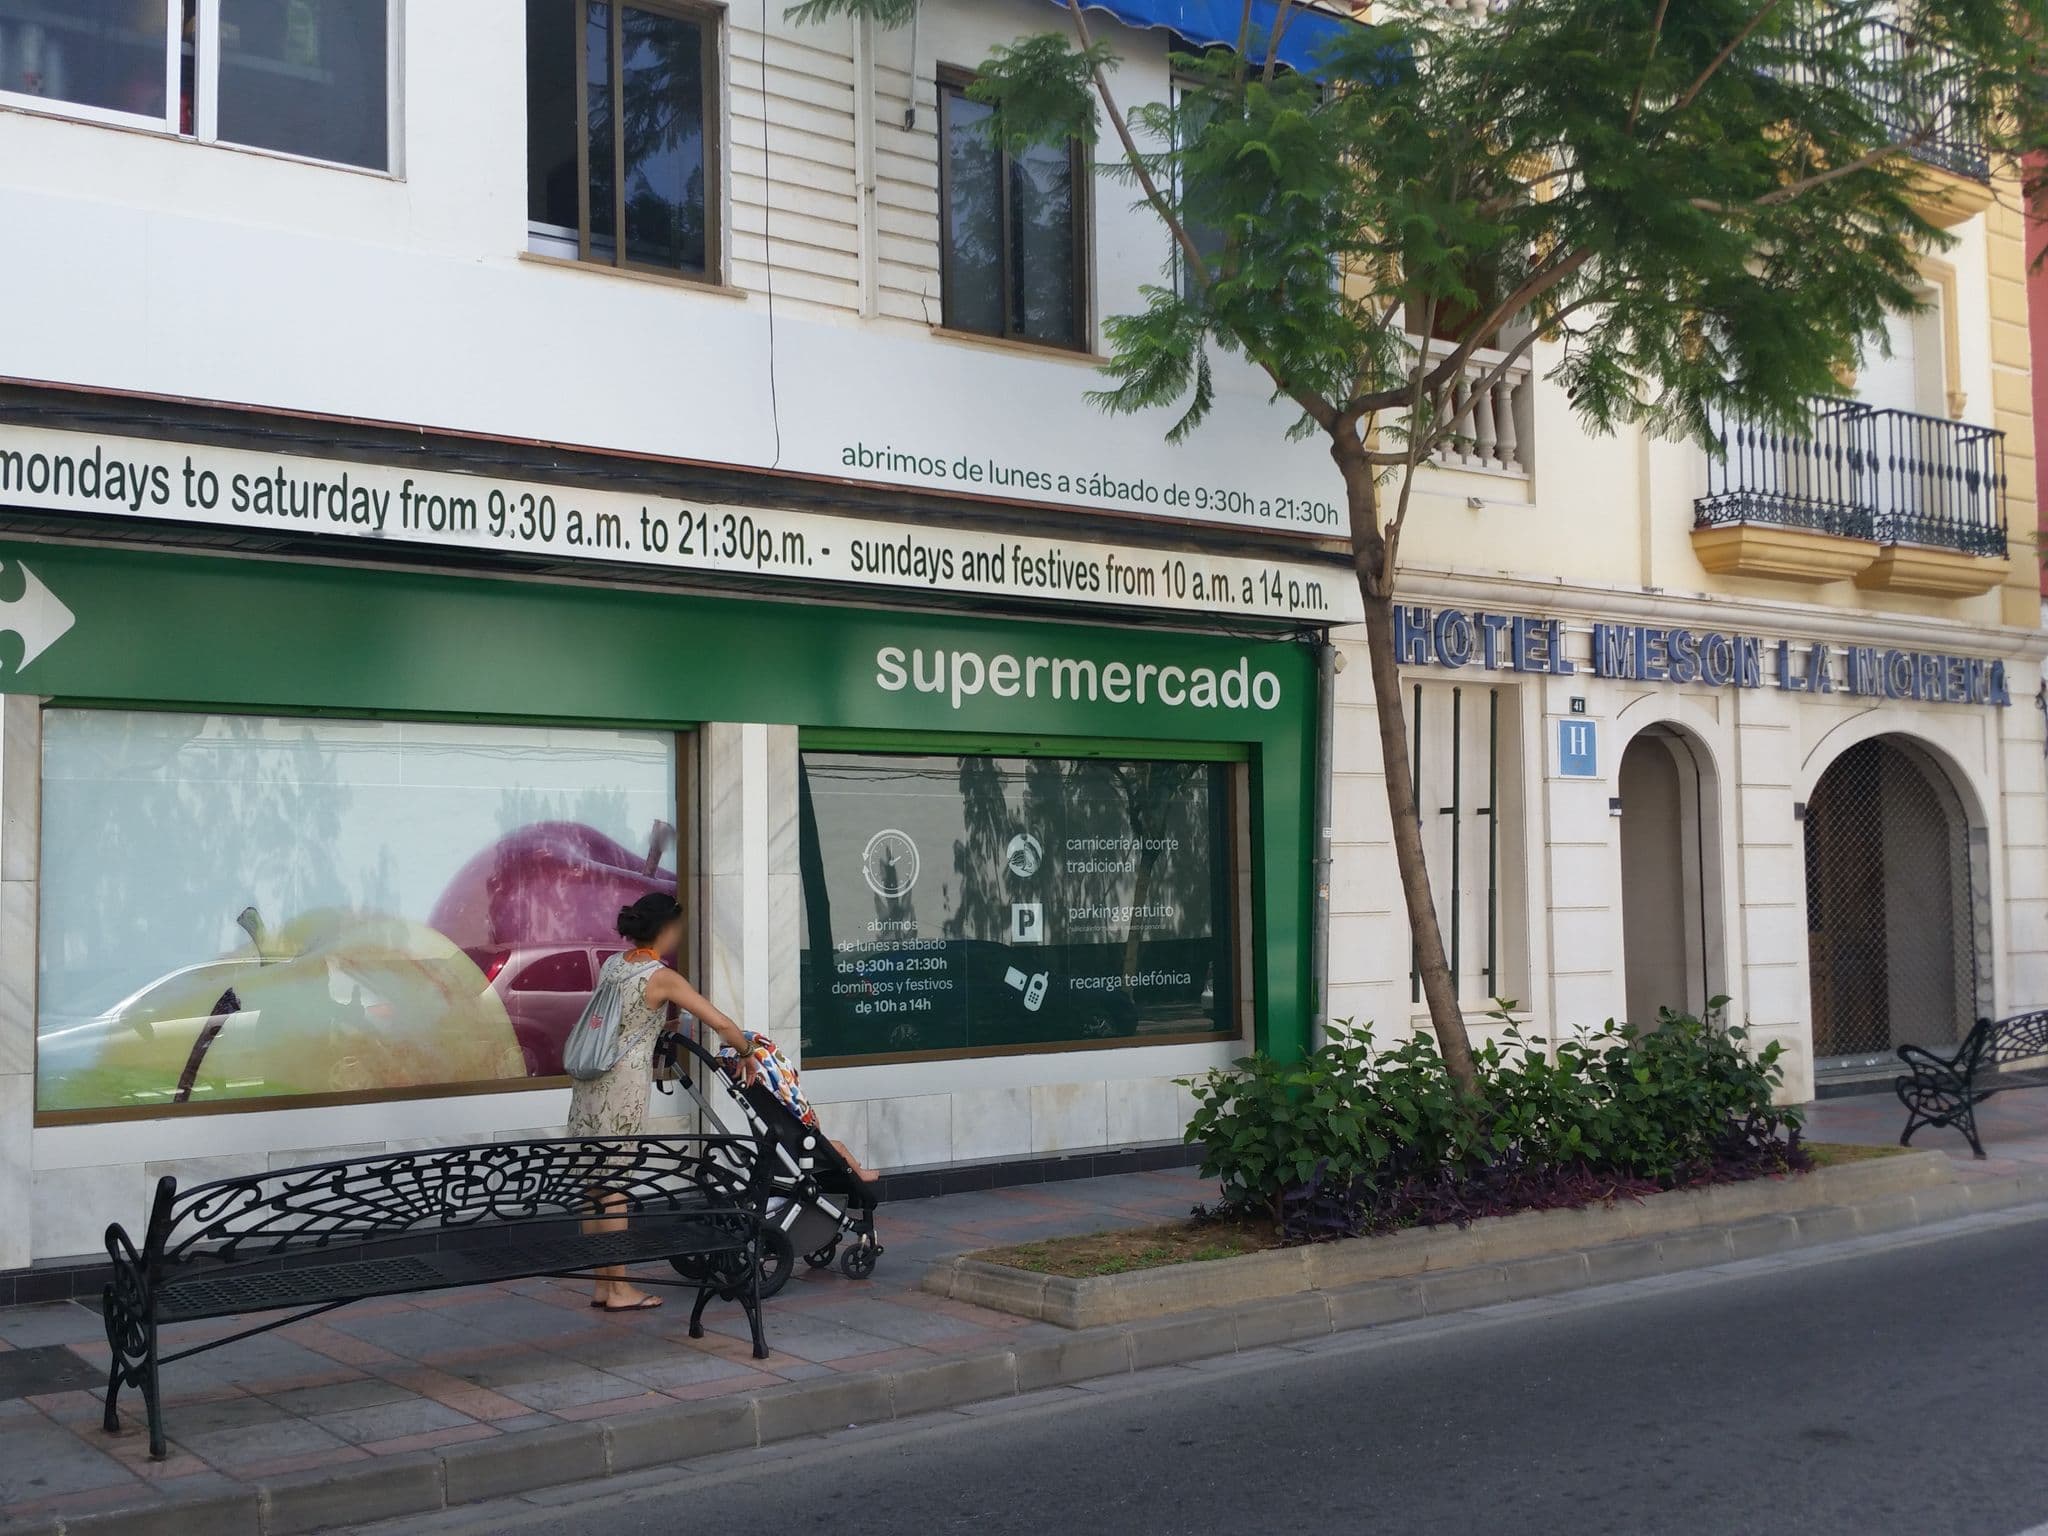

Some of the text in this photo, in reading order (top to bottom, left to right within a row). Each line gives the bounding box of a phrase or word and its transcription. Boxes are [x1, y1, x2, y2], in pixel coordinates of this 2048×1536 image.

[842, 442, 1338, 525] abrimos de lunes a sábado de 9:30h a 21:30h
[0, 445, 170, 511] mondays
[183, 456, 219, 509] to
[232, 466, 390, 531] saturday
[400, 479, 477, 531] from
[488, 489, 556, 542] 9:30
[566, 510, 630, 549] a.m.
[641, 506, 669, 552] to
[851, 534, 953, 584] sundays
[962, 543, 1005, 585] and
[1012, 545, 1100, 592] festives
[1106, 553, 1155, 597] from
[1161, 559, 1186, 599] 10
[1193, 572, 1236, 603] a.m.
[1242, 576, 1253, 605] a
[1259, 569, 1283, 607] 14
[1289, 576, 1328, 612] p.m.
[1393, 605, 2012, 706] HOTEL MESON LA MORENA
[876, 646, 1281, 710] supermercado
[1570, 726, 1588, 756] H
[1131, 836, 1143, 850] al
[1145, 838, 1178, 850] corte
[1067, 858, 1135, 873] tradicional
[1069, 903, 1174, 922] parking gratuito
[867, 918, 918, 931] abrimos
[1019, 909, 1035, 936] P
[838, 938, 946, 952] de lunes a sábado
[838, 957, 947, 973] de 9:30h a 21:30h
[832, 977, 953, 996] domingos y festivos
[1070, 971, 1191, 991] recarga telefónica
[856, 998, 931, 1014] de 10h a 14h
